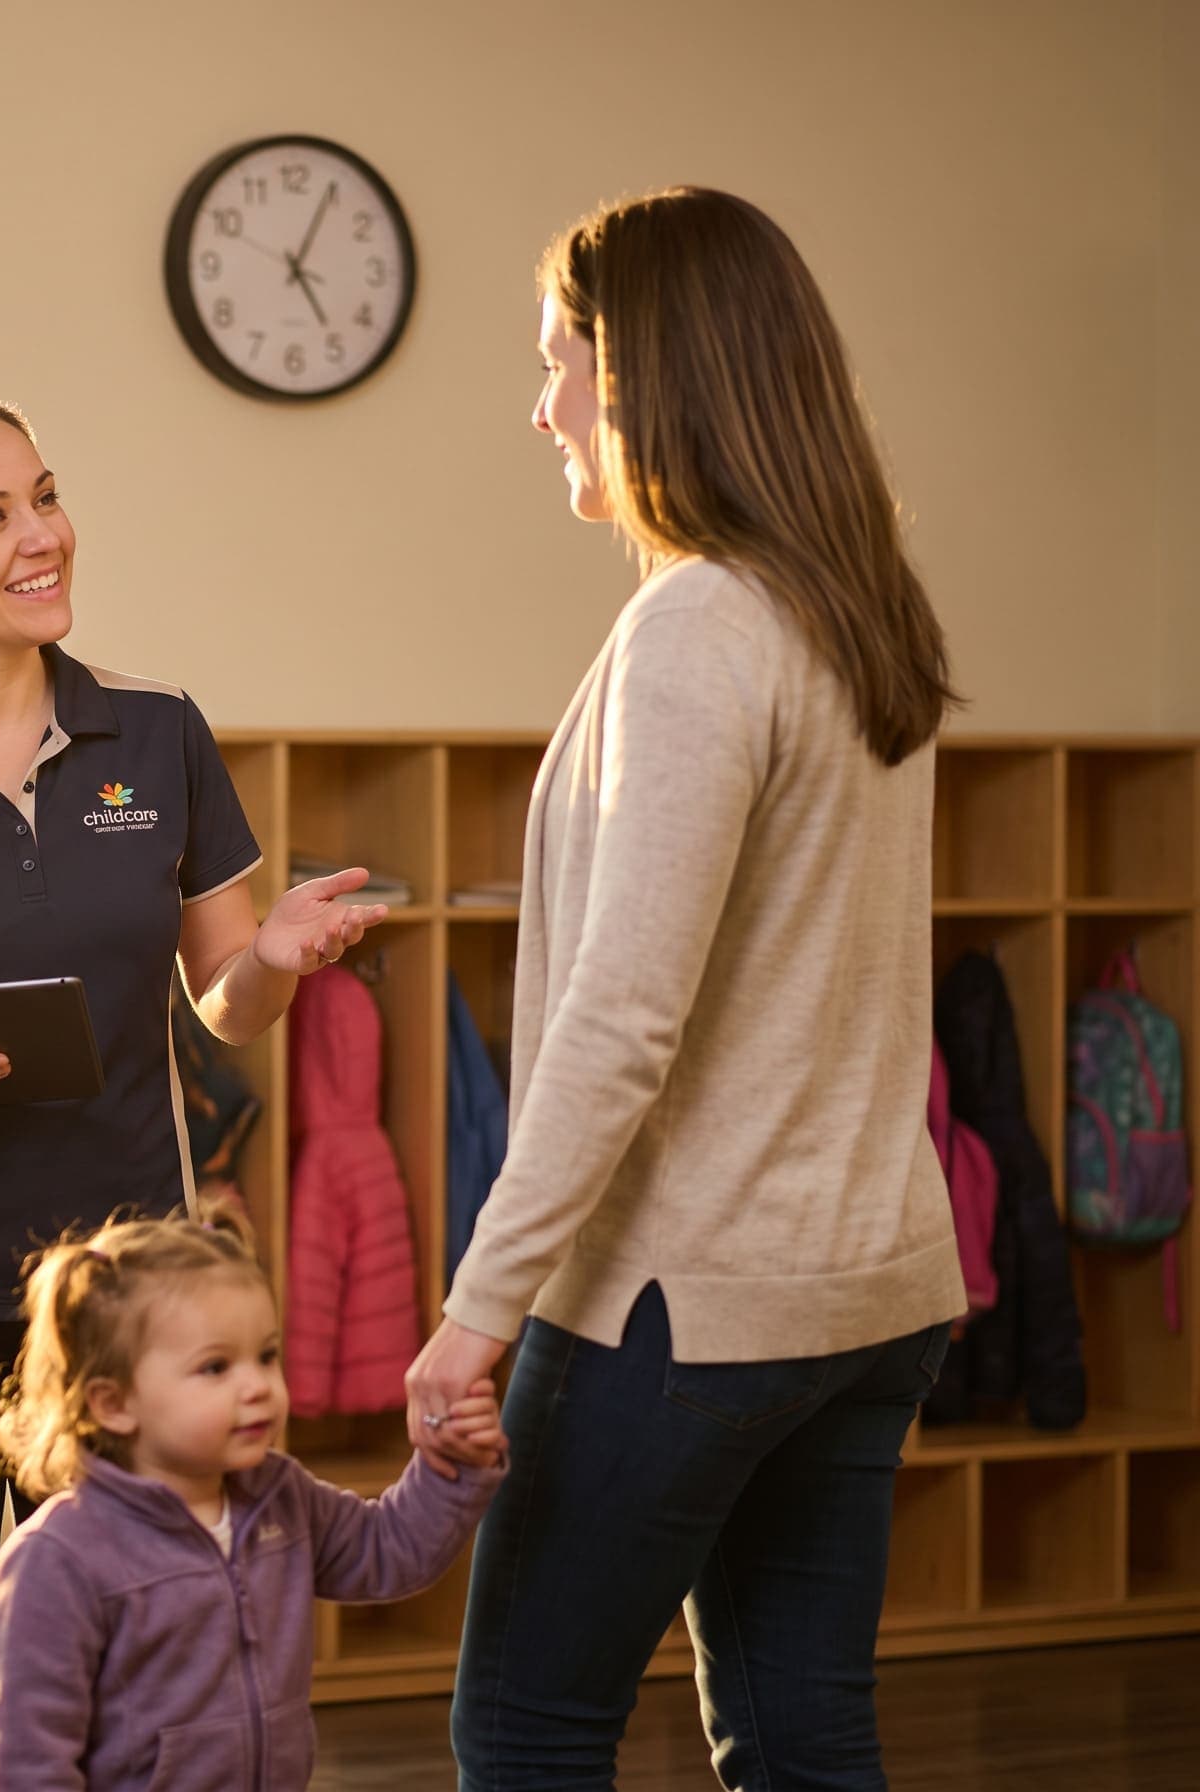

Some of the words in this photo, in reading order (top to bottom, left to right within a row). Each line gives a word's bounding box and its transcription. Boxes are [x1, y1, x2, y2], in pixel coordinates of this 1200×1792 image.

[243, 178, 267, 205] 11
[278, 163, 312, 195] 12
[212, 207, 244, 239] 10
[352, 210, 373, 243] 2
[200, 250, 222, 282] 9
[364, 255, 387, 288] 3
[212, 297, 235, 330] 8
[352, 301, 373, 329] 4
[246, 330, 266, 361] 7
[283, 343, 307, 376] 6
[324, 331, 346, 364] 5
[83, 808, 158, 826] childcare
